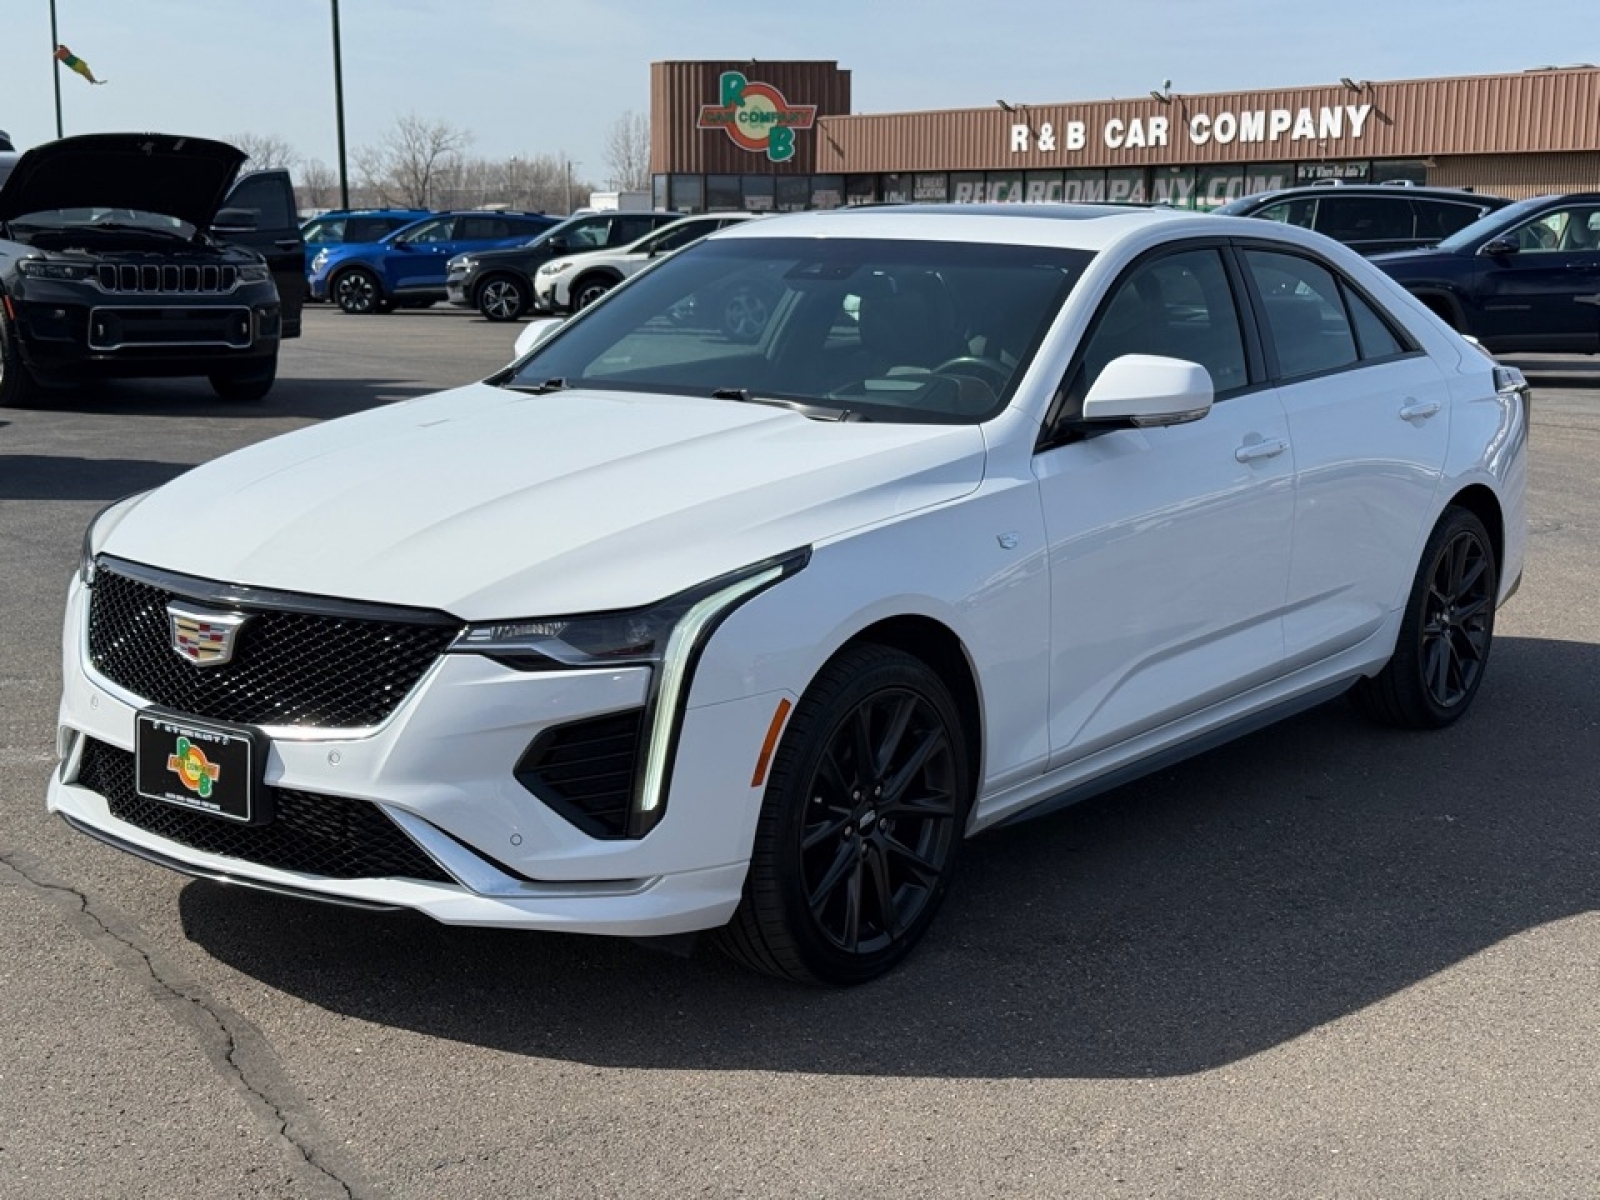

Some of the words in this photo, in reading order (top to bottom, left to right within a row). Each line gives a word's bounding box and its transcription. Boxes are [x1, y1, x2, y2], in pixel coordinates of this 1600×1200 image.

[720, 70, 747, 107] R
[738, 111, 808, 124] COMPANY
[1011, 124, 1029, 152] R
[1038, 122, 1056, 152] &
[1066, 121, 1086, 151] B
[1104, 116, 1169, 149] CAR
[1189, 104, 1371, 145] COMPANY
[768, 126, 795, 162] B
